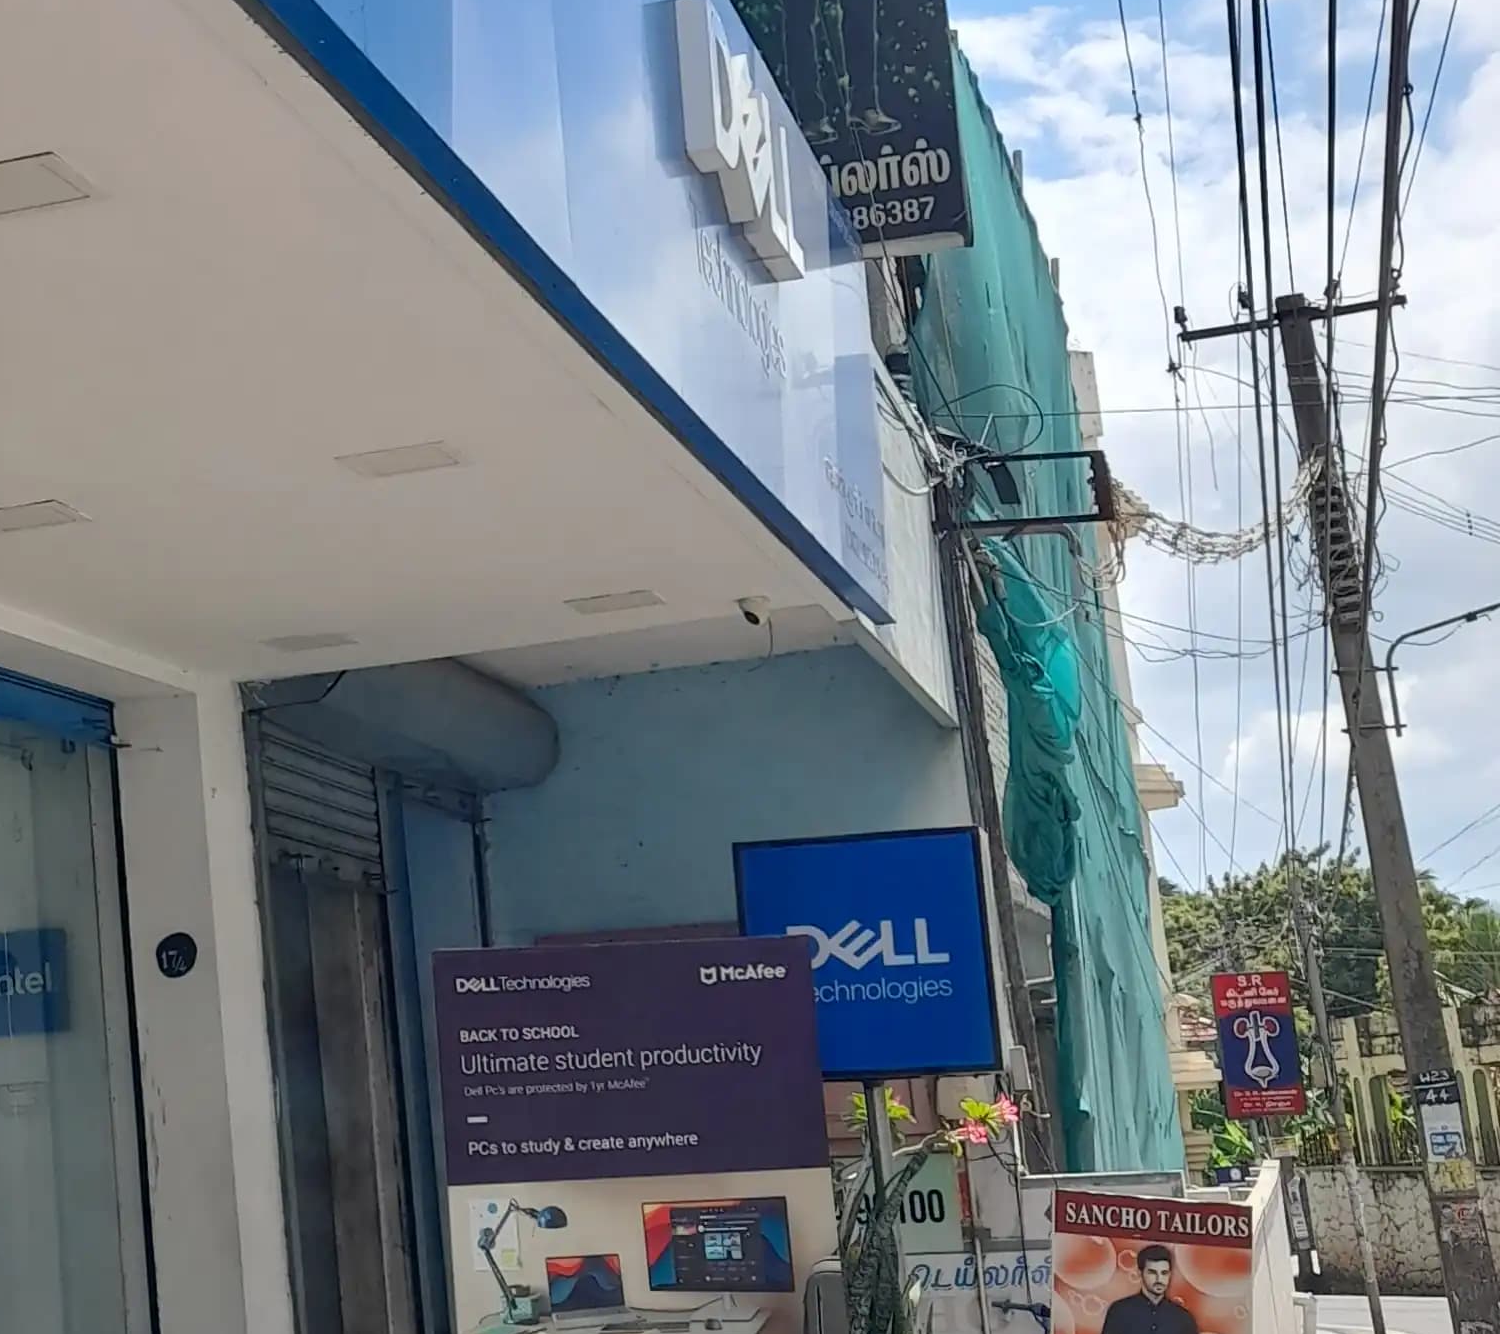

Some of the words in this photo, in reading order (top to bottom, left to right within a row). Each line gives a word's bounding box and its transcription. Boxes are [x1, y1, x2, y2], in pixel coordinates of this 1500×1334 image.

[786, 918, 951, 970] DELL
[720, 963, 787, 981] McAfee
[455, 977, 500, 993] DELL
[460, 1030, 498, 1043] BACK
[500, 1028, 519, 1041] TO
[522, 1025, 580, 1040] SCHOOL
[460, 1051, 550, 1075] Ultimate
[555, 1047, 635, 1071] student
[640, 1040, 762, 1071] productivity
[467, 1141, 499, 1156] PCs
[501, 1140, 518, 1155] to
[520, 1138, 562, 1155] study
[563, 1137, 575, 1152] &
[578, 1135, 625, 1151] create
[628, 1132, 699, 1150] anywhere
[1065, 1201, 1151, 1231] SANCHO
[1156, 1209, 1250, 1238] TAILORS
